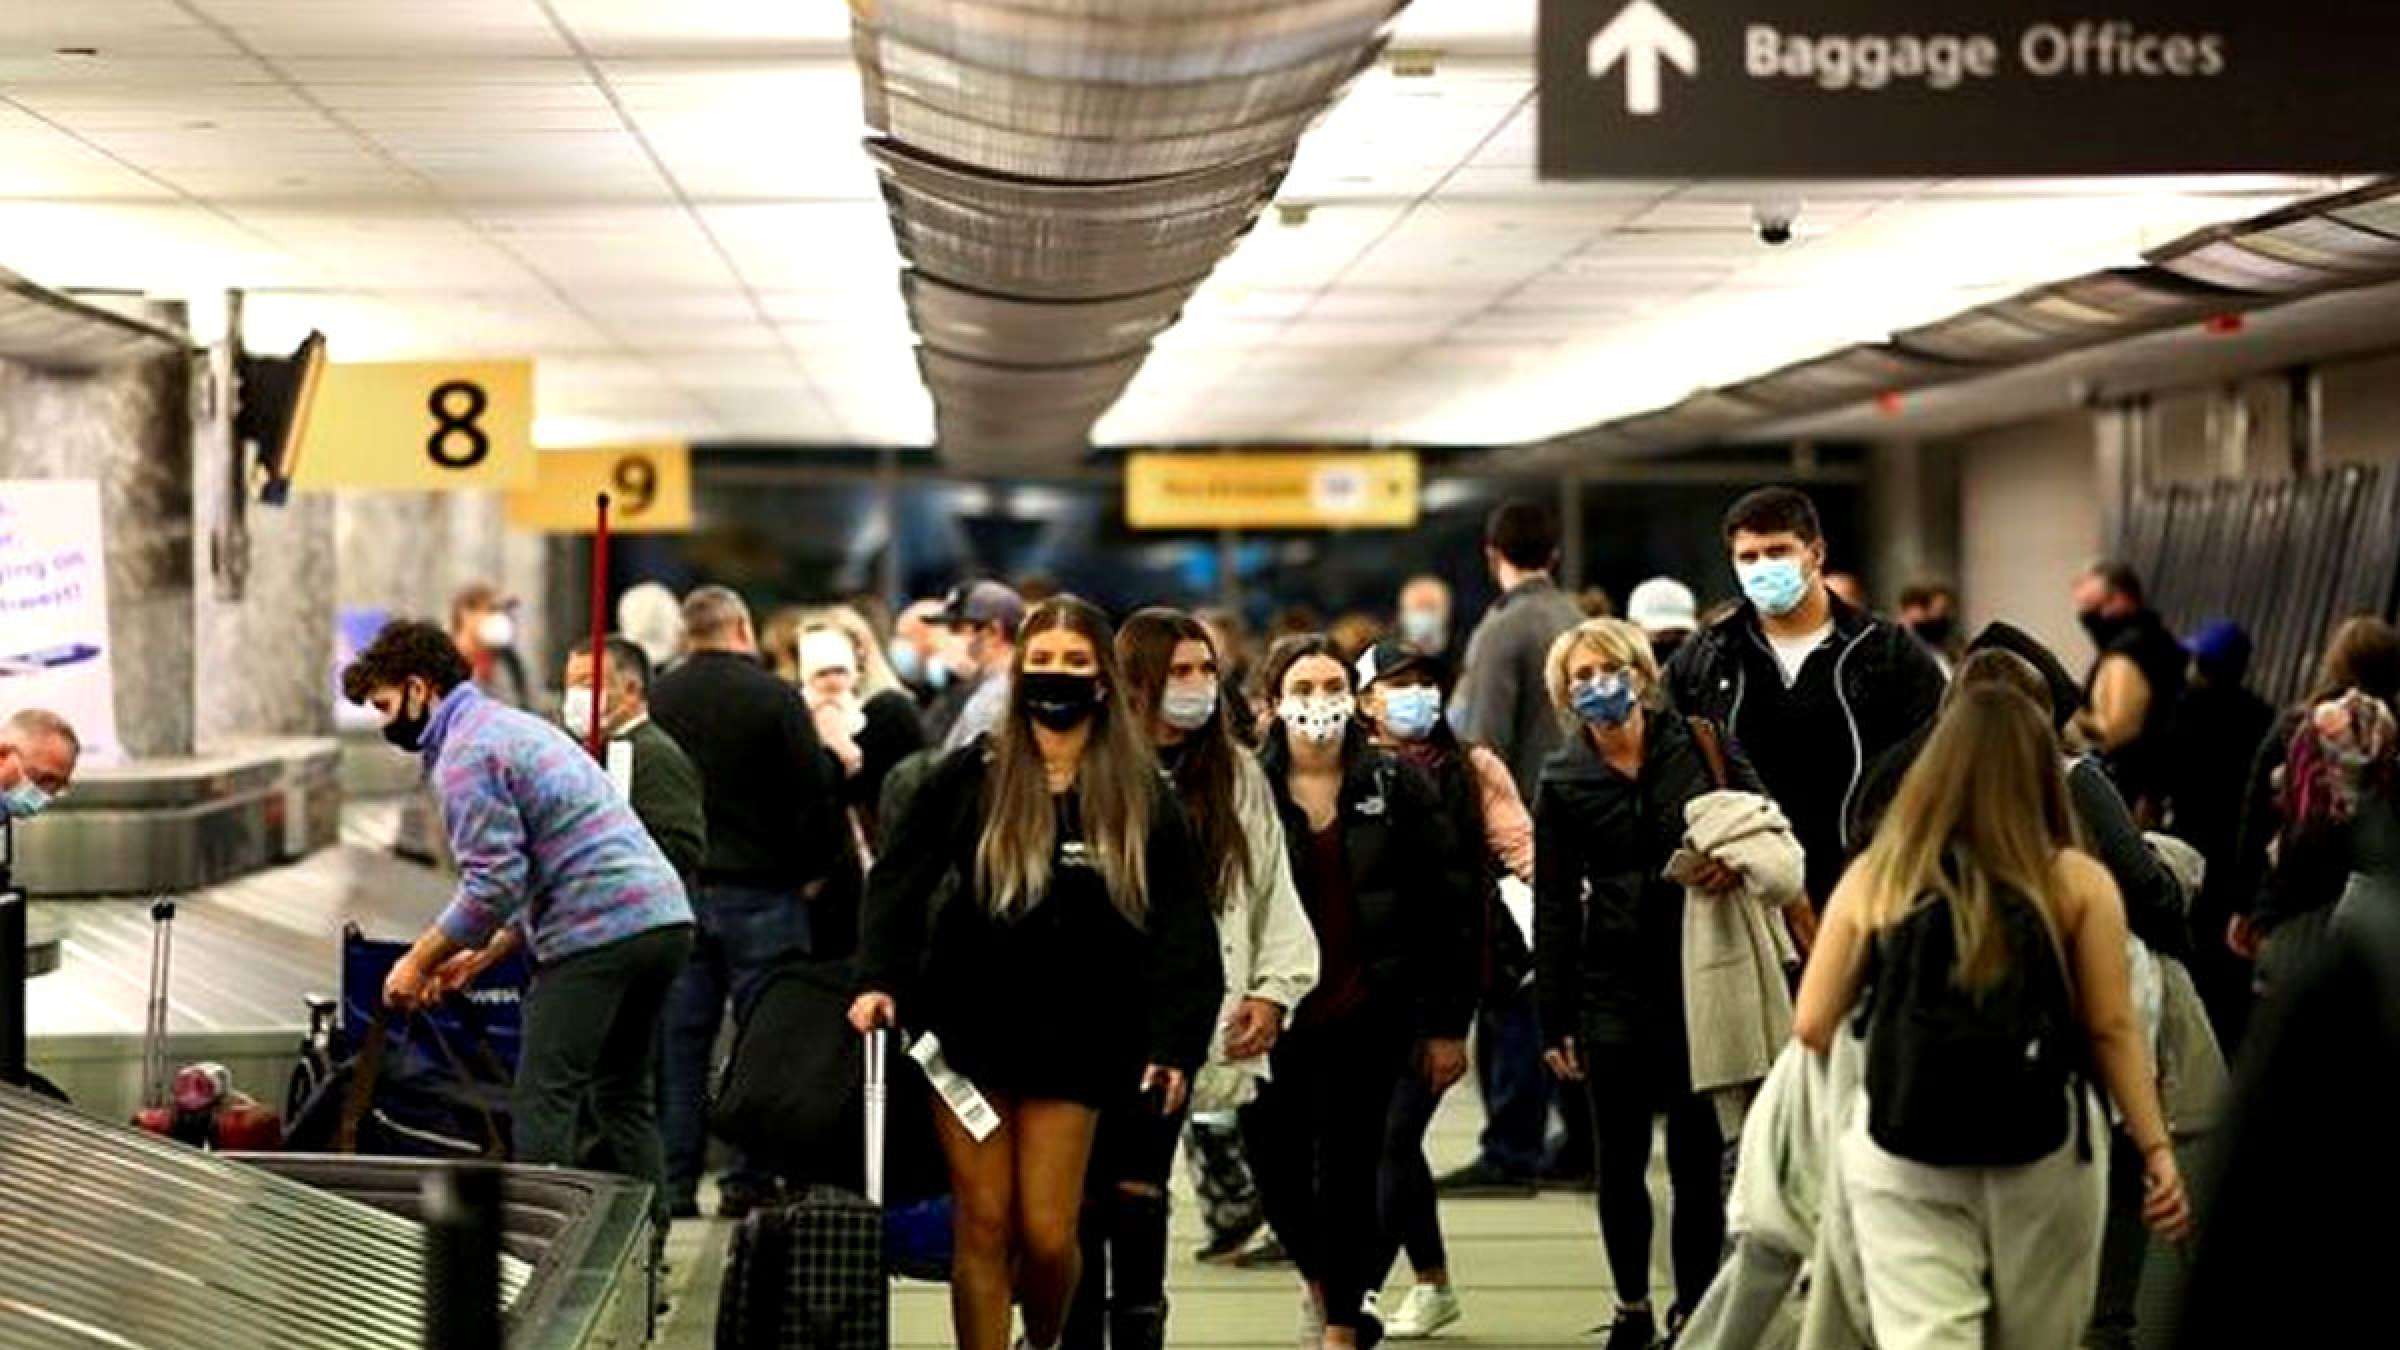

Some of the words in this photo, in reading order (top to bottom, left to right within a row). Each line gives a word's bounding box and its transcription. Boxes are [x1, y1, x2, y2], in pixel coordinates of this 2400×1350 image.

[1743, 23, 1997, 90] Baggage
[2020, 22, 2224, 76] Offices
[427, 380, 489, 469] 8
[612, 454, 657, 517] 9
